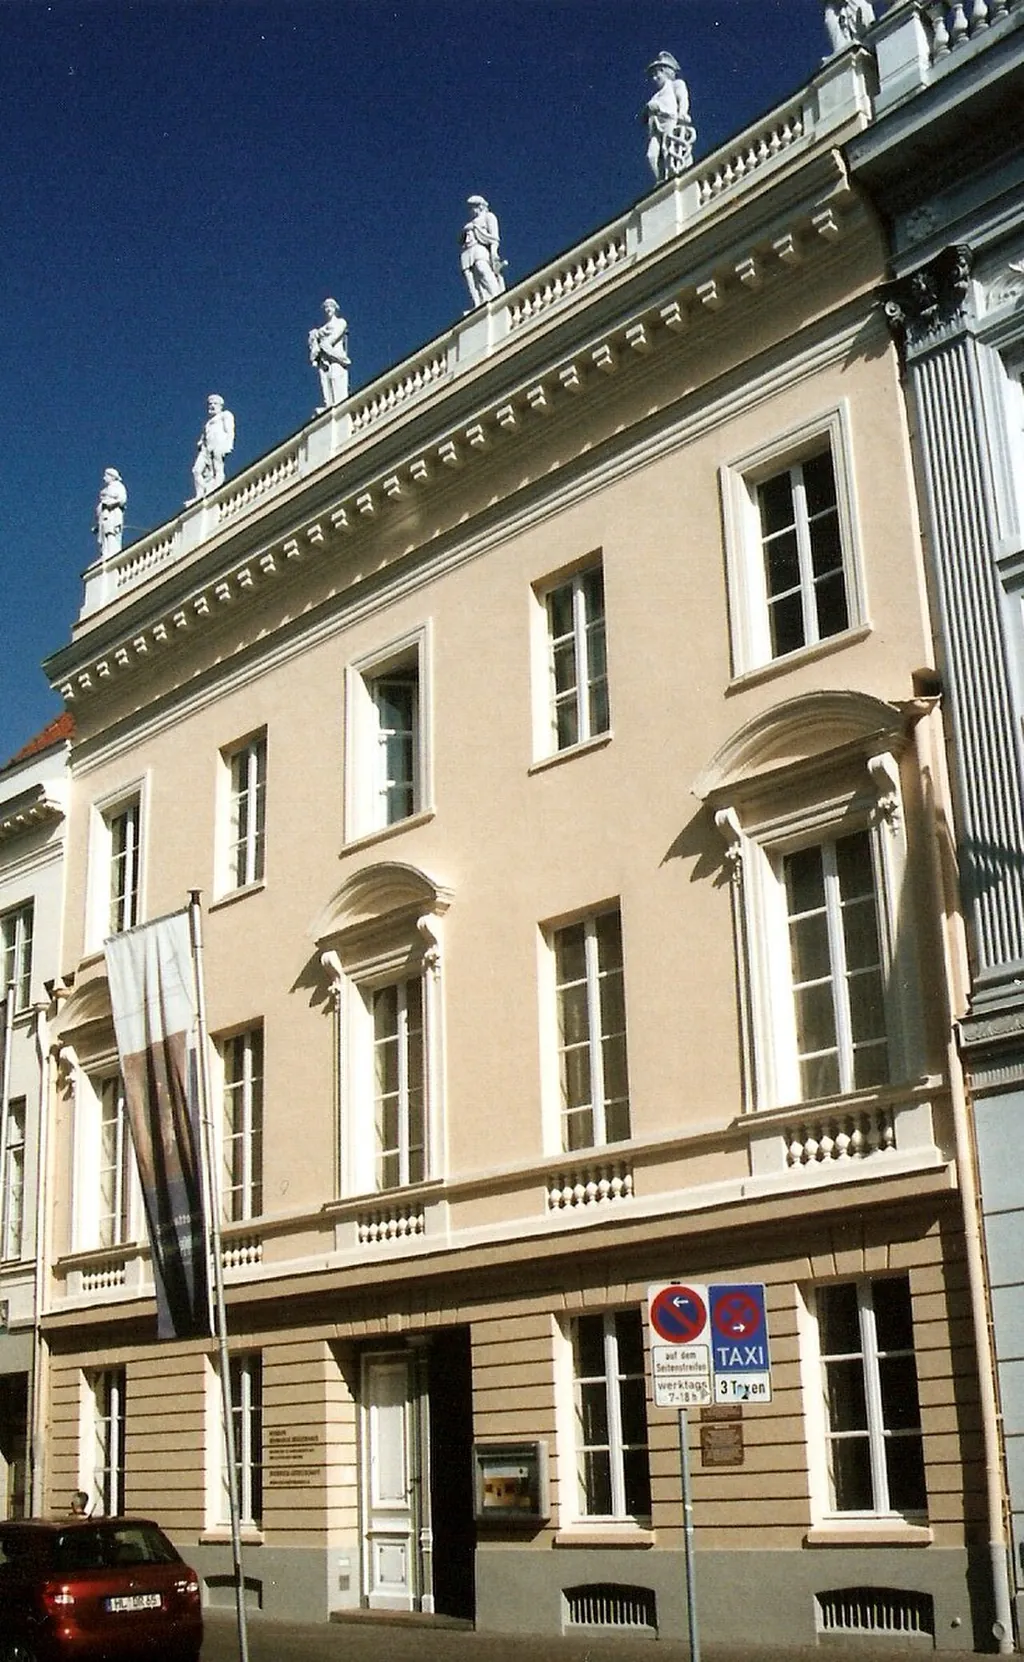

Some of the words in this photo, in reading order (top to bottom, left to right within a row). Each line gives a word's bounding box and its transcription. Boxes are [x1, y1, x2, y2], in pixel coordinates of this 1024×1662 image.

[666, 1351, 677, 1360] auf
[681, 1351, 696, 1360] dem
[717, 1346, 764, 1366] TAXI
[656, 1362, 706, 1373] Seitenstreifen
[657, 1380, 707, 1391] werktags
[721, 1380, 727, 1394] 3
